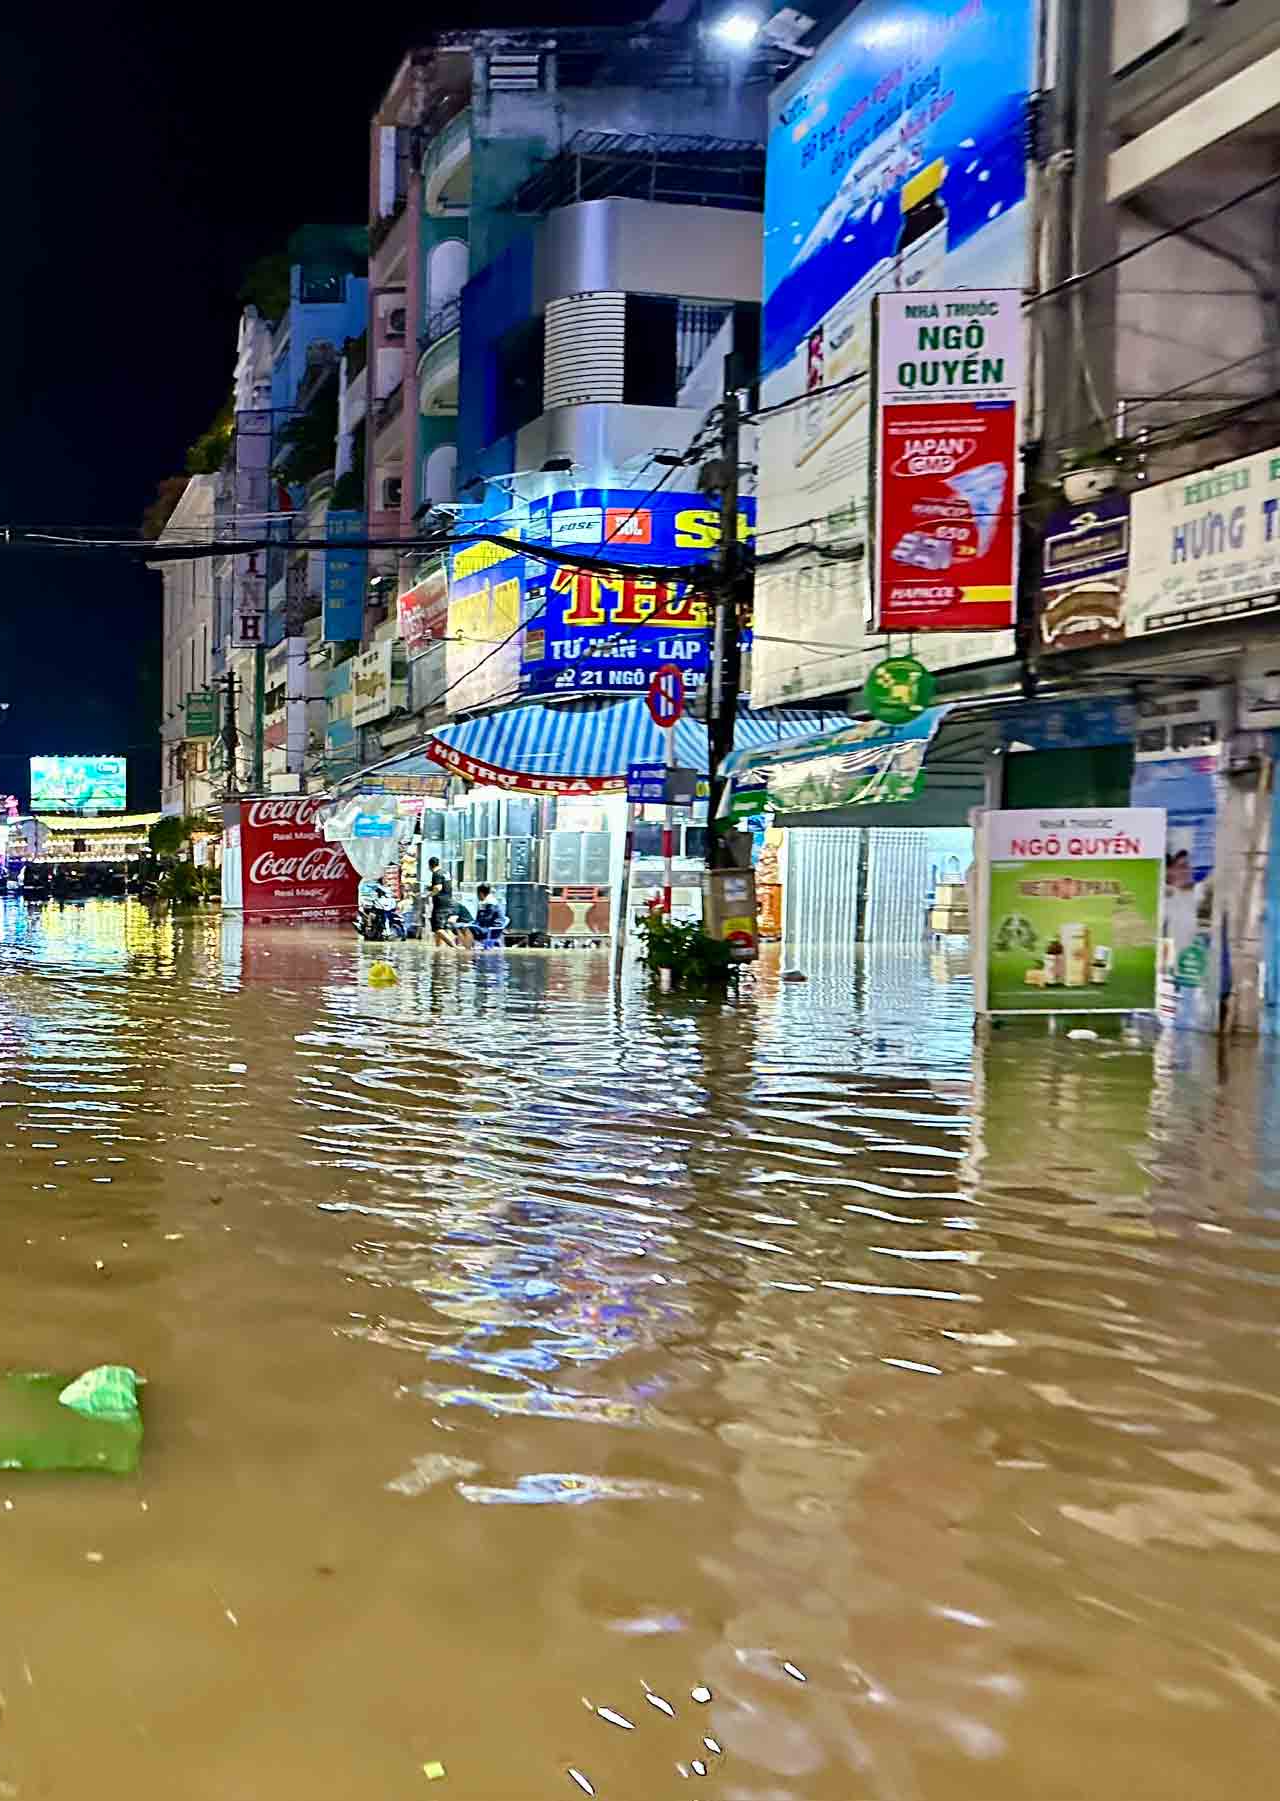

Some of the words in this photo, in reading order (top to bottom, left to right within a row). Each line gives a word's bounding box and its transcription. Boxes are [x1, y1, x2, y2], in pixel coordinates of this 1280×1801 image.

[904, 304, 939, 319] NHÀ
[917, 319, 985, 351] NGÔ
[903, 439, 965, 459] JAPAN
[579, 670, 604, 686] 21
[608, 668, 645, 686] NGÔ
